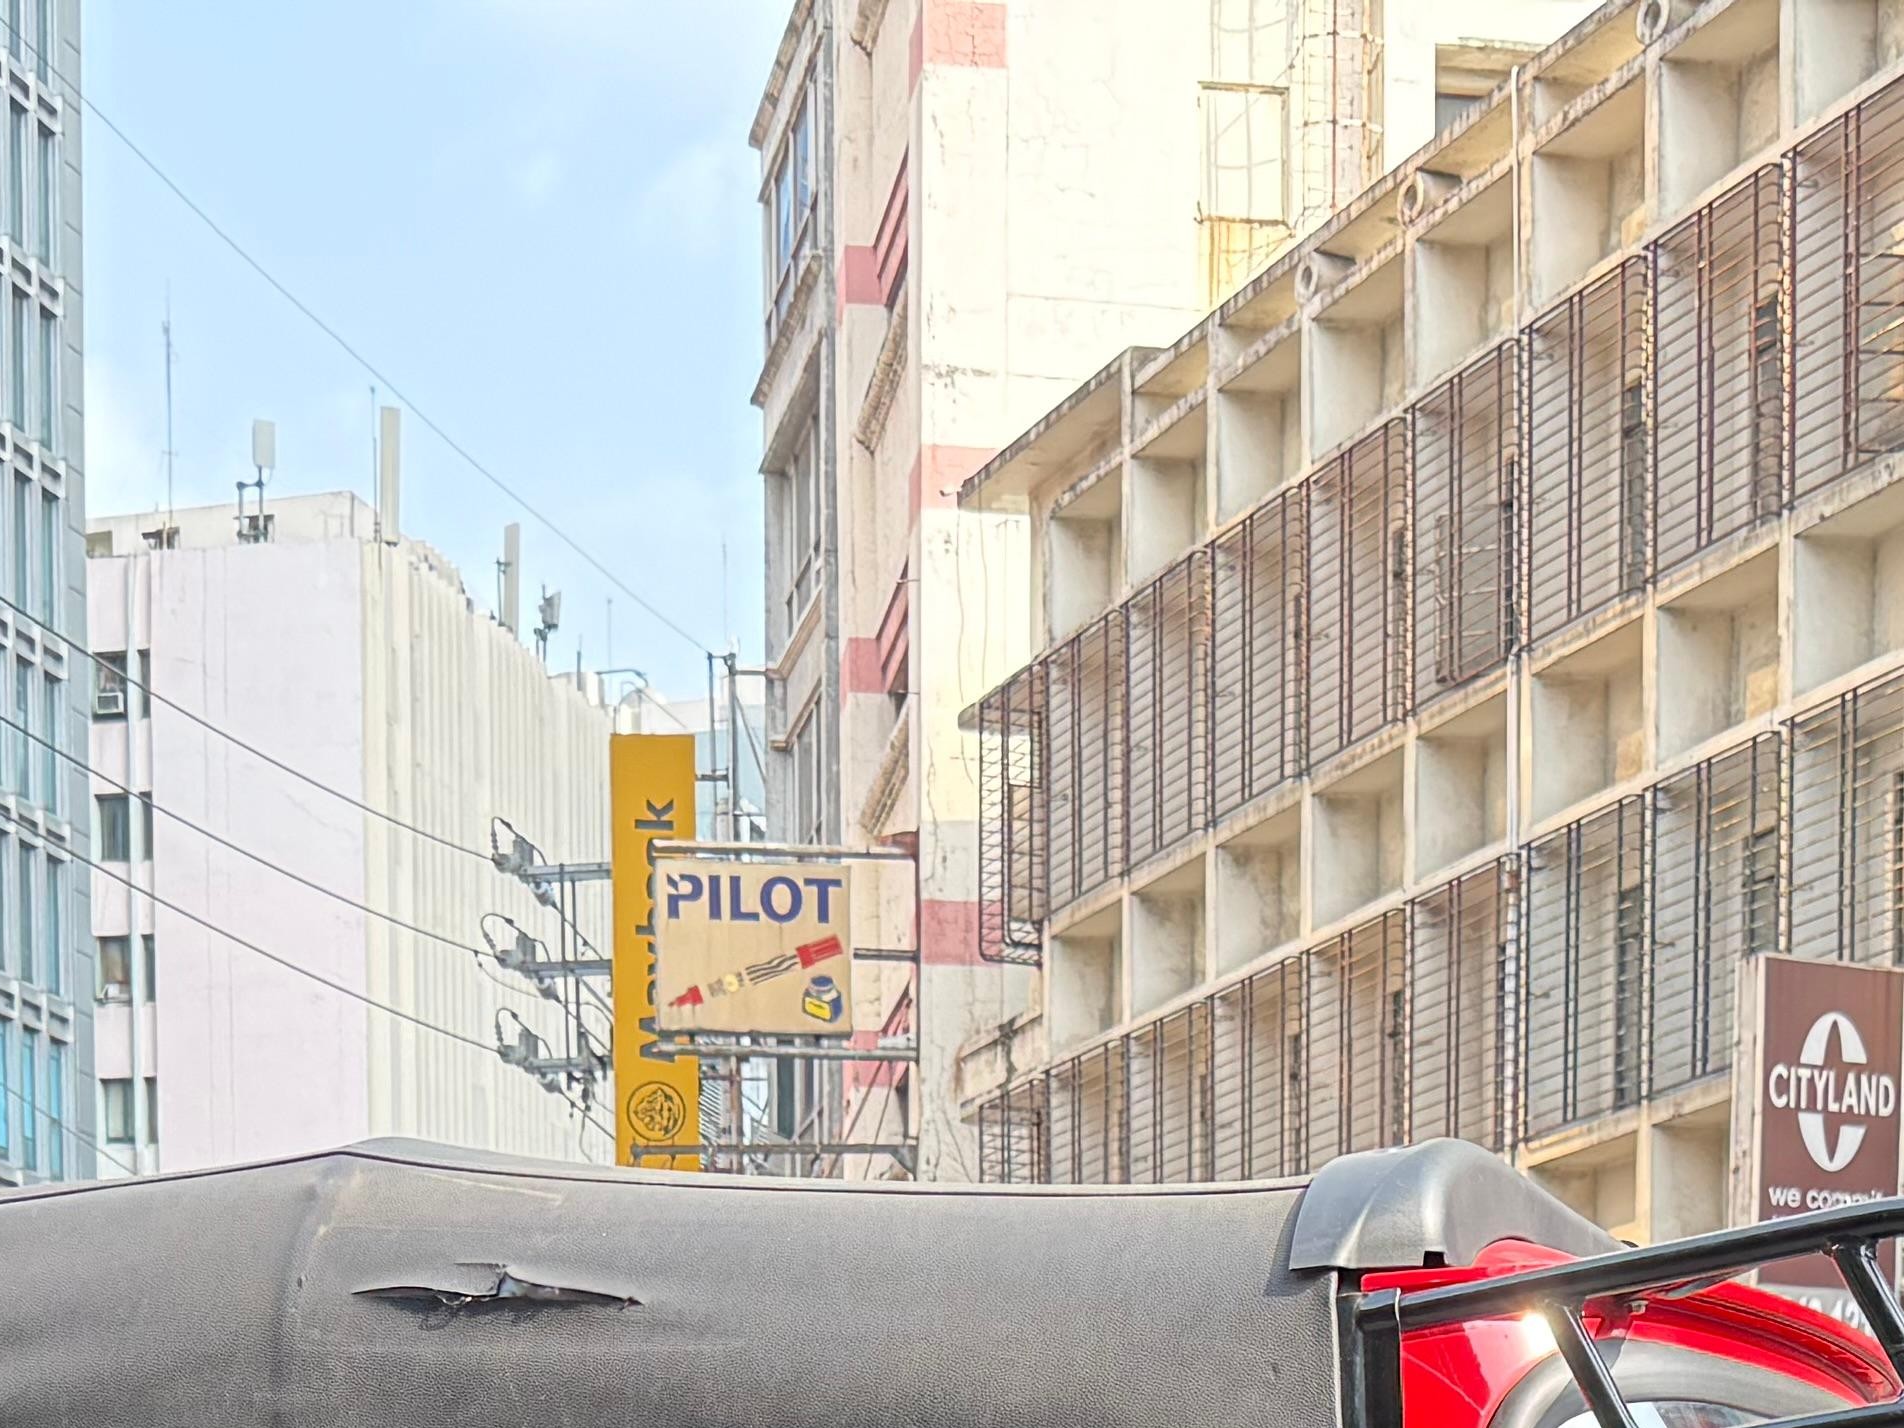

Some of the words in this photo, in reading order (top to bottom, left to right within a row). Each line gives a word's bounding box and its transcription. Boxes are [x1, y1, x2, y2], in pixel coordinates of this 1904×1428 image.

[666, 873, 842, 924] PILOT
[1769, 1064, 1895, 1117] CITYLAND
[1768, 1186, 1801, 1208] we
